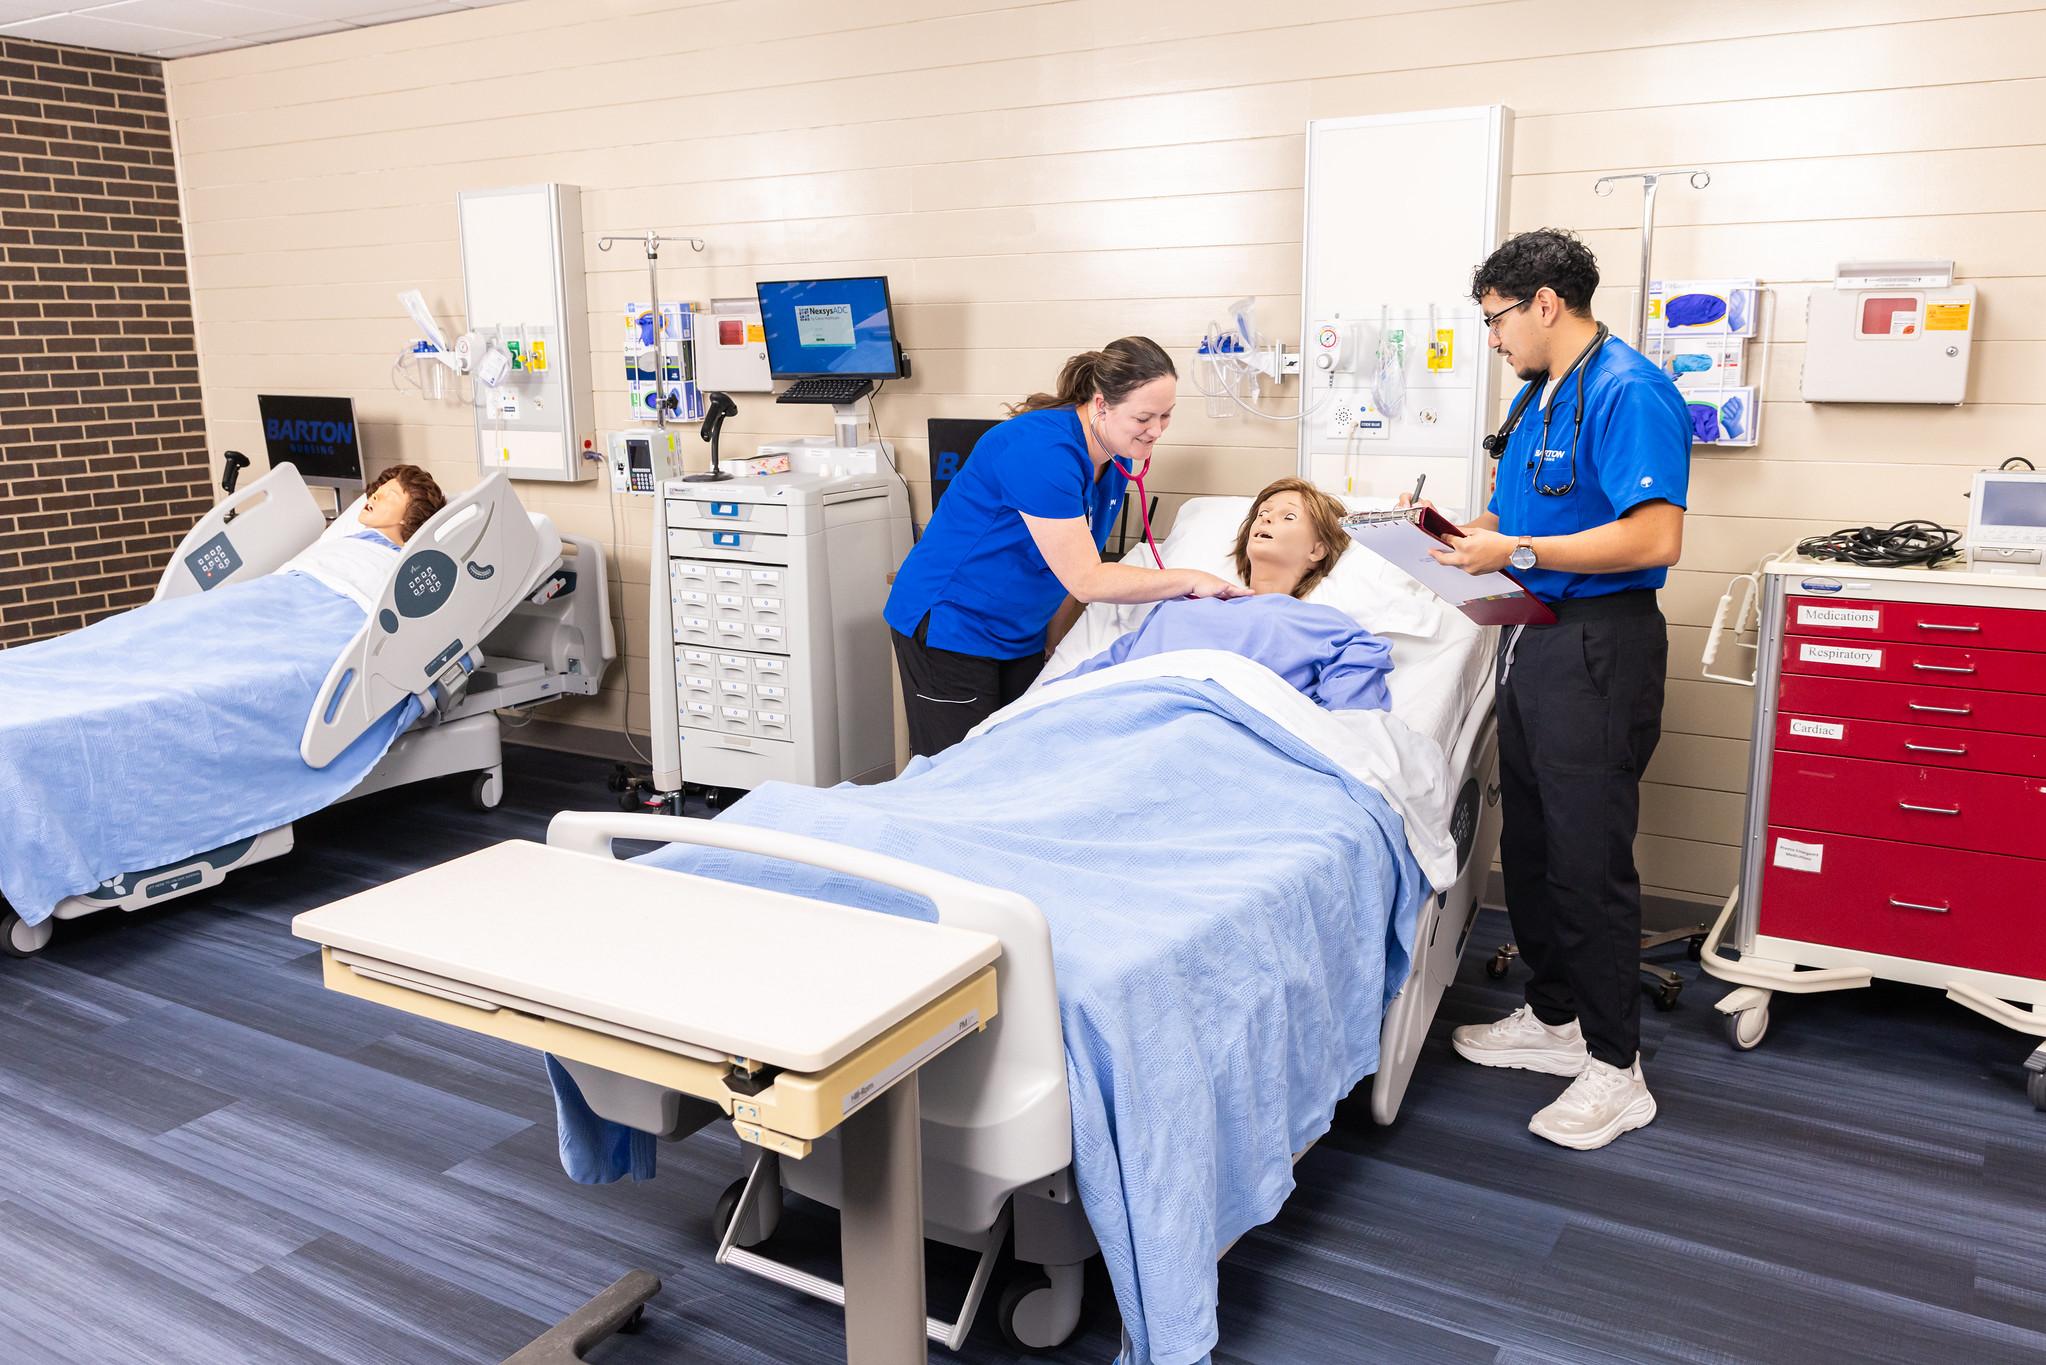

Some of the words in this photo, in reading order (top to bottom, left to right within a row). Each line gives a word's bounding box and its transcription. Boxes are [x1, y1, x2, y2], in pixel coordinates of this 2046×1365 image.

[809, 306, 848, 316] NexsysADC
[267, 418, 353, 444] BARTON
[288, 443, 335, 455] NURSING
[1806, 609, 1874, 622] Medications
[1809, 647, 1873, 662] Respiratory
[1792, 722, 1835, 735] Cardiac
